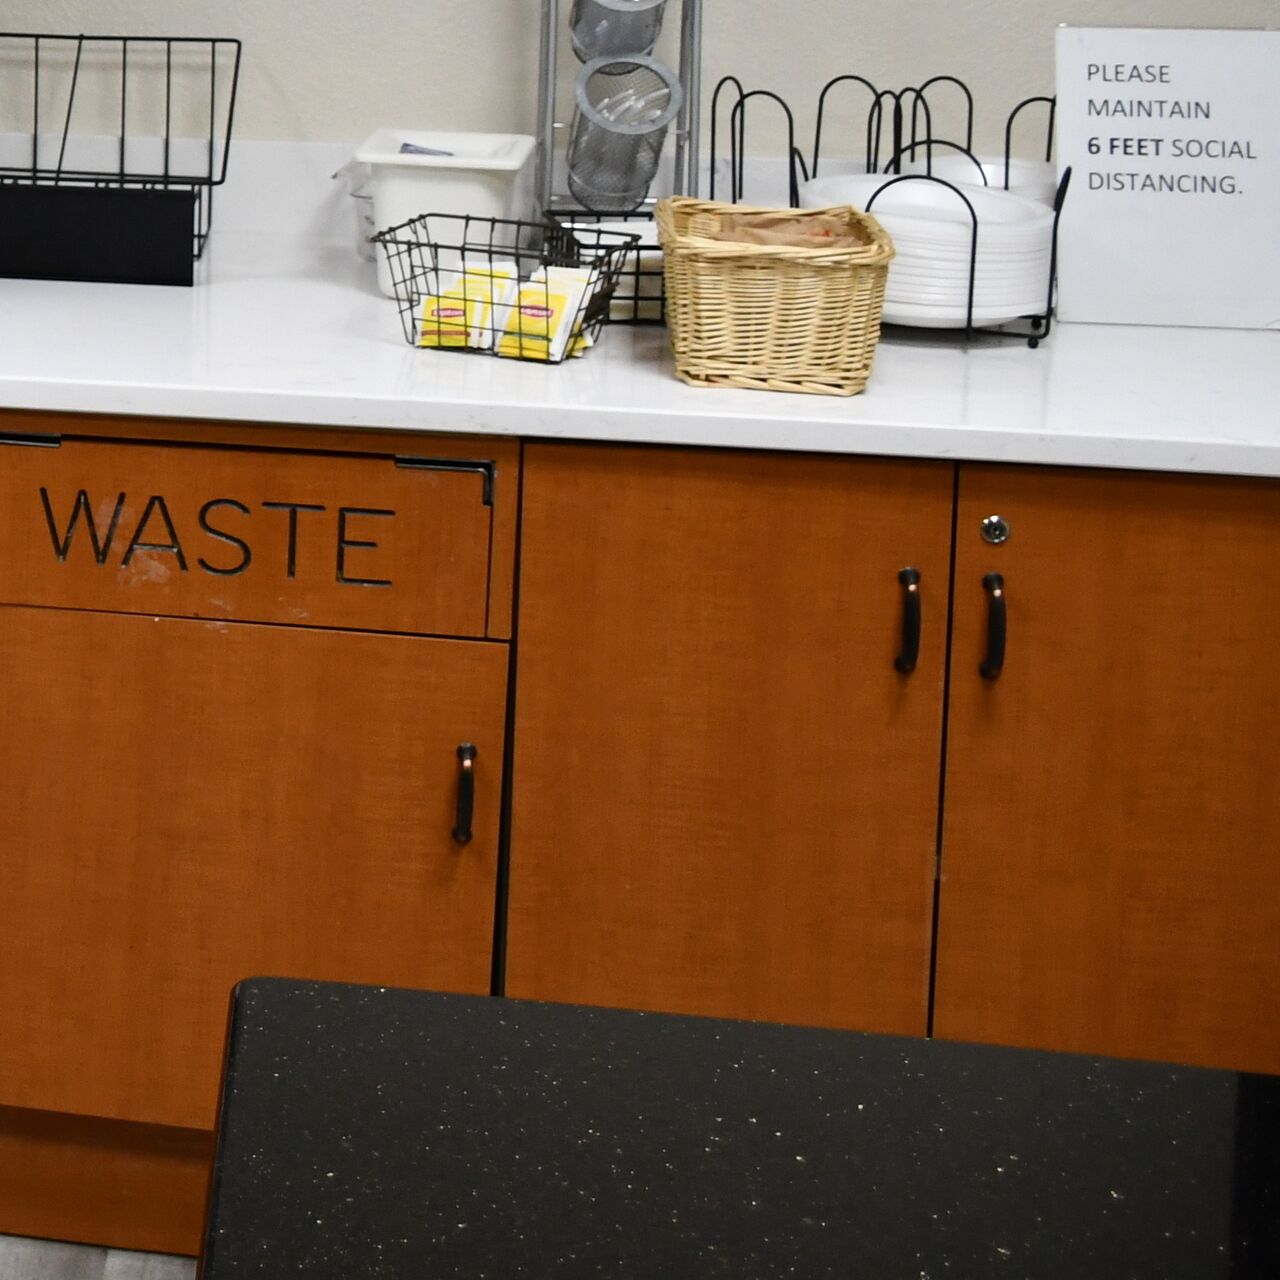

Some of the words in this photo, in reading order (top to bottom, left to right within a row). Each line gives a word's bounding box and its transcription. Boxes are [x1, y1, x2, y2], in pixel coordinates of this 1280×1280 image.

[1087, 64, 1171, 83] PLEASE
[1088, 99, 1211, 119] MAINTAIN
[1088, 137, 1100, 155] 6
[1109, 137, 1164, 156] FEET
[1171, 139, 1257, 159] SOCIAL
[1088, 172, 1243, 194] DISTANCING.
[40, 486, 395, 588] WASTE
